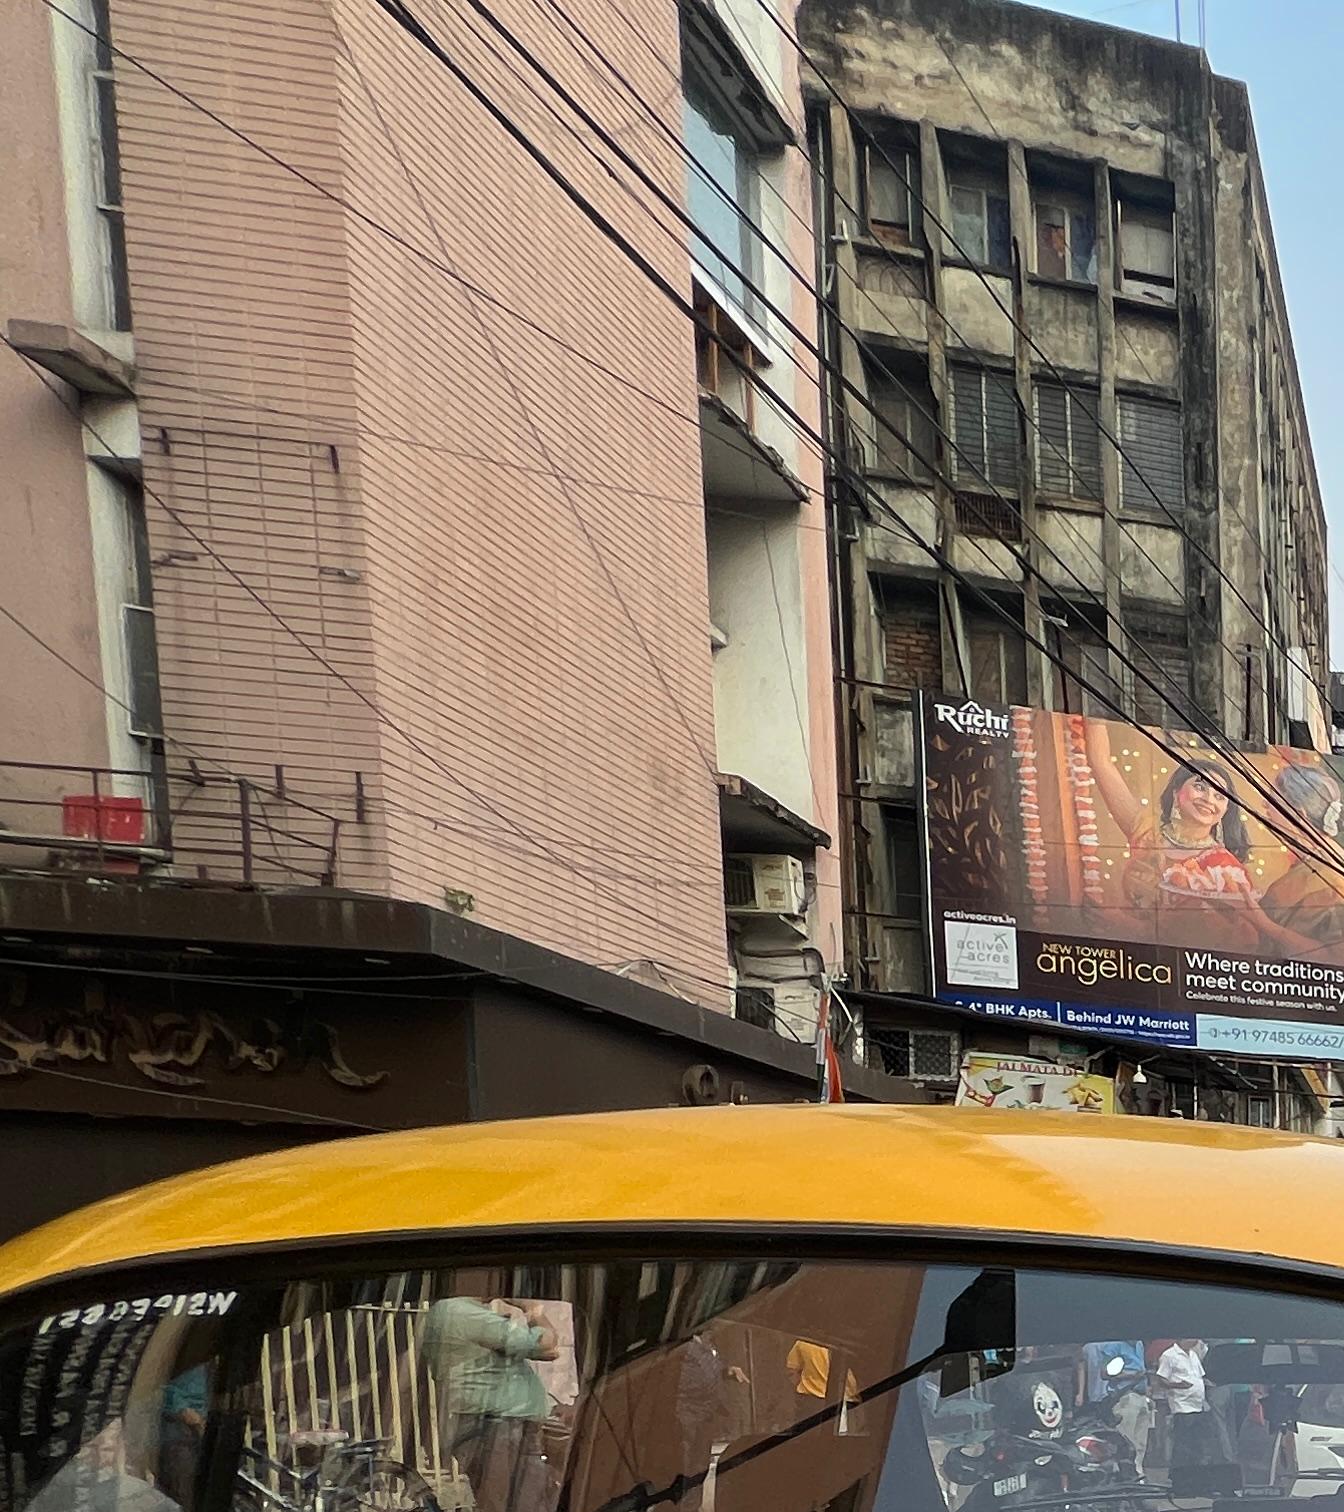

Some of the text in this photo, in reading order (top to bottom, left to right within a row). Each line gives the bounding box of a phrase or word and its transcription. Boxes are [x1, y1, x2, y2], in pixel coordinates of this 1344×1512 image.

[934, 701, 1009, 733] Ruchi
[957, 939, 1004, 952] active
[1043, 942, 1116, 959] NEW TOWER
[967, 952, 1009, 964] acres
[1037, 949, 1172, 985] angelica
[1185, 951, 1344, 983] Where traditions
[1186, 973, 1236, 991] meet
[1230, 994, 1245, 1004] this
[986, 1003, 1015, 1016] BHK
[1018, 1006, 1052, 1021] Apts.
[1066, 1010, 1111, 1024] Behind
[1115, 1013, 1135, 1026] JW
[1139, 1017, 1190, 1031] Marriott
[1222, 1028, 1248, 1040] +91
[1252, 1030, 1296, 1044] 97485
